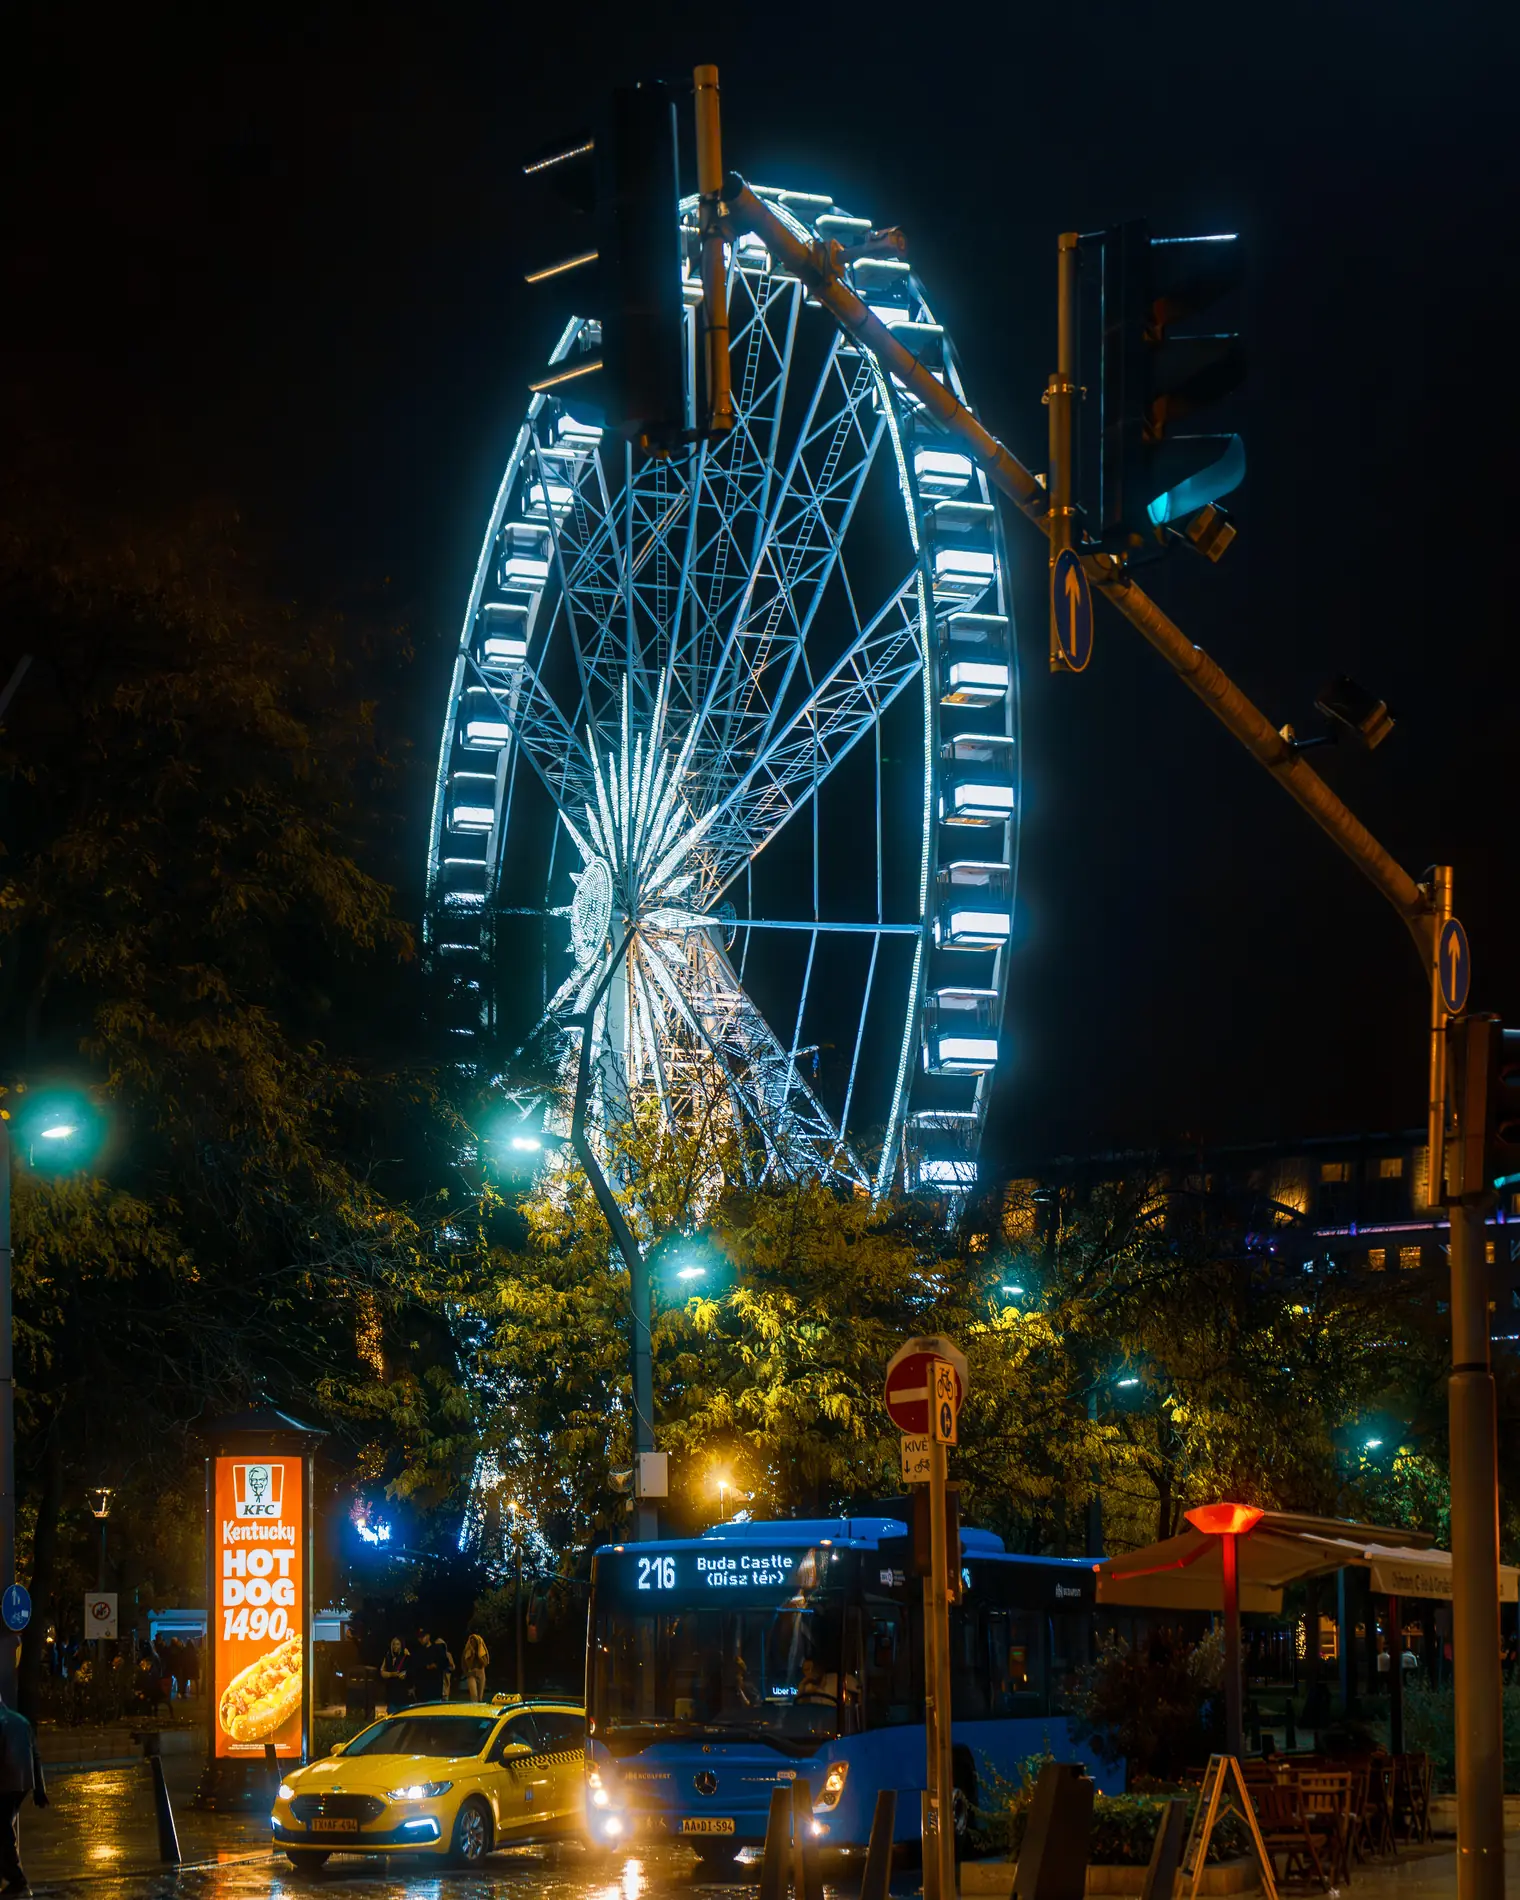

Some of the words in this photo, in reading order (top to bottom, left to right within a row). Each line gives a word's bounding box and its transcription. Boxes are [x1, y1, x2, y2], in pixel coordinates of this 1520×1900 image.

[243, 1504, 275, 1516] KFC
[223, 1520, 295, 1546] Kentucky
[223, 1549, 295, 1577] HOT
[638, 1557, 676, 1590] 216
[697, 1557, 737, 1570] Buda
[741, 1555, 793, 1569] Castle
[707, 1572, 747, 1587] (Dísz
[752, 1570, 784, 1586] tér)
[223, 1578, 295, 1606] DOG
[223, 1608, 288, 1641] 1490
[772, 1686, 789, 1695] Uber
